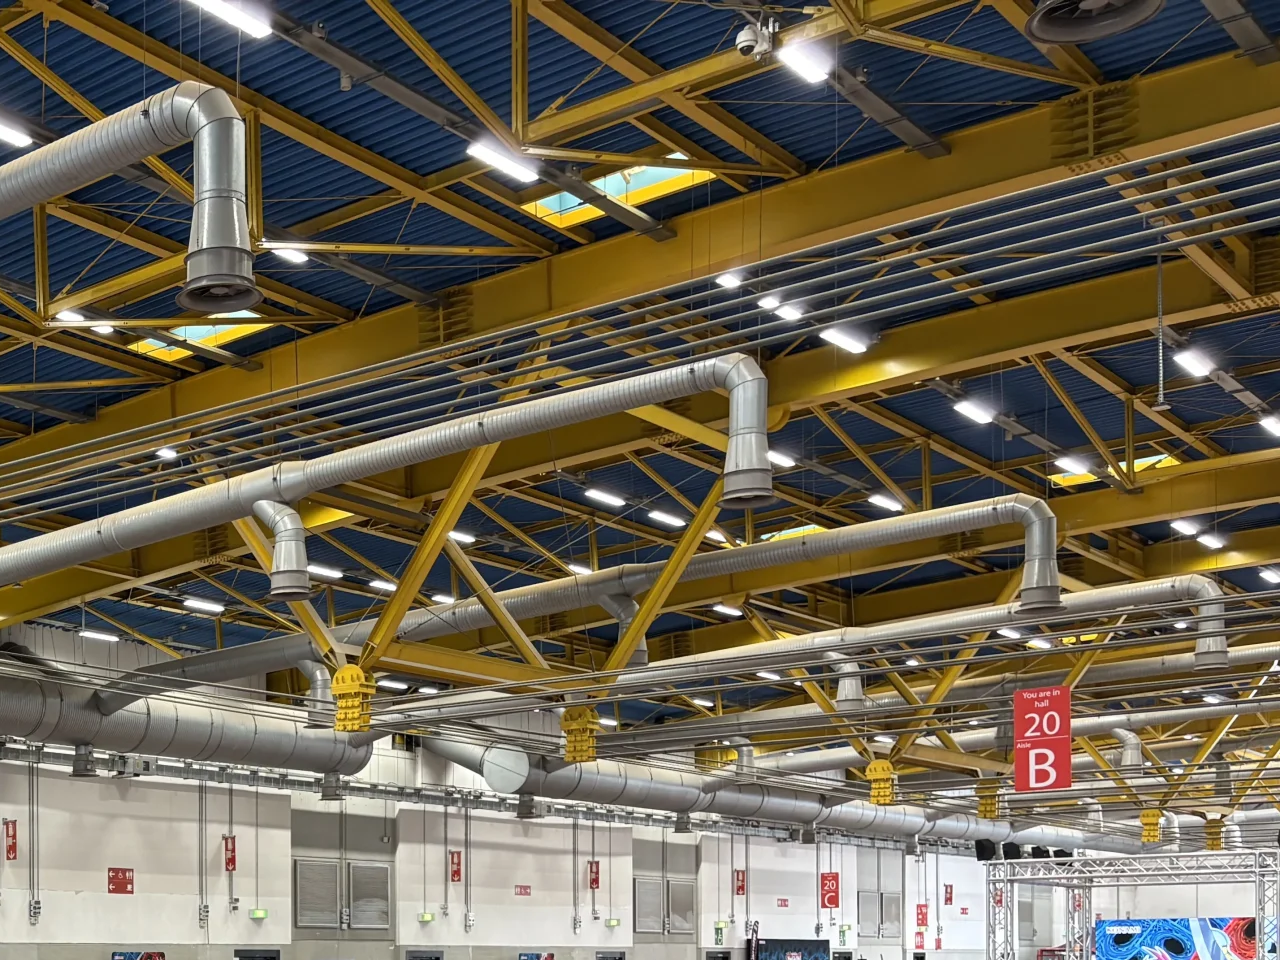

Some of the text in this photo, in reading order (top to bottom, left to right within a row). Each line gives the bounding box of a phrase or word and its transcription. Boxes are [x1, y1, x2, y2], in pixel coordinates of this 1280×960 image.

[1034, 699, 1049, 708] hall
[1024, 711, 1061, 737] 20
[1028, 748, 1057, 788] B
[823, 880, 836, 890] 20
[824, 892, 836, 907] C
